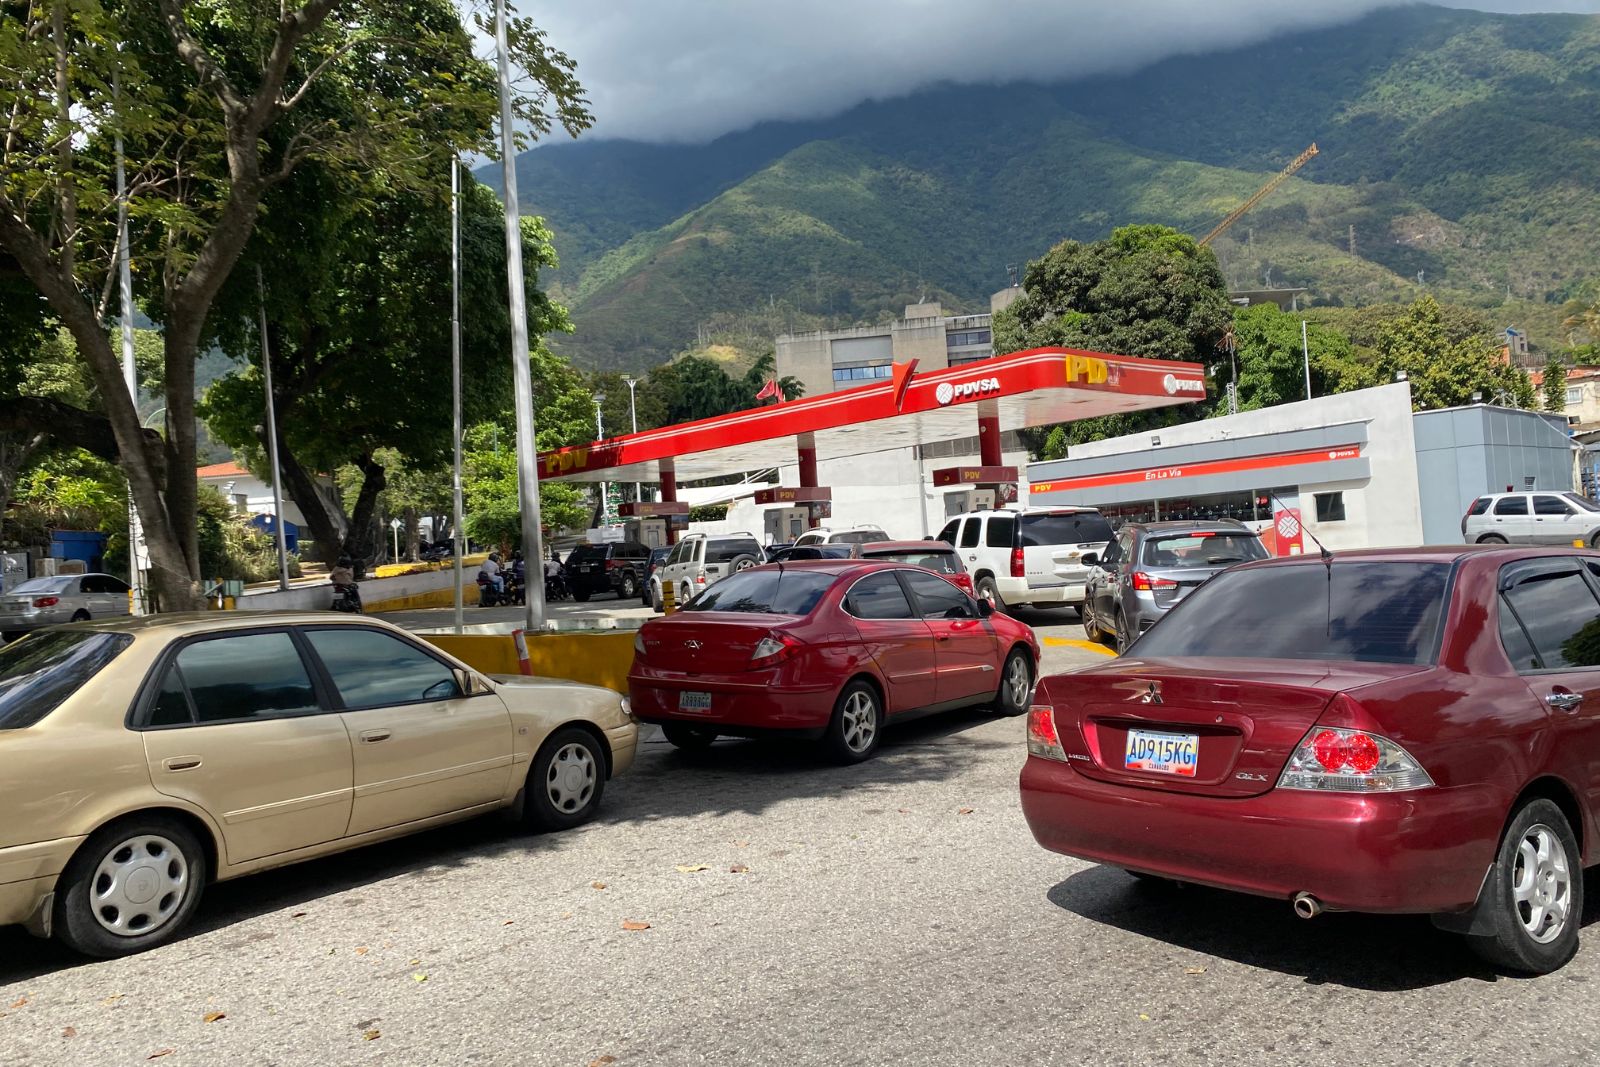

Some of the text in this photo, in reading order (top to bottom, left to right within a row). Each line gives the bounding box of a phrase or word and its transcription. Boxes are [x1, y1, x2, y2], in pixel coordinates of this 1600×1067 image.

[954, 377, 1000, 397] PDVSA
[546, 448, 588, 473] PDV
[964, 471, 980, 480] PDV
[1145, 472, 1156, 480] En
[1157, 470, 1167, 479] La
[1034, 484, 1052, 492] PDV
[780, 490, 796, 499] PDV
[1129, 737, 1192, 764] AD915KG
